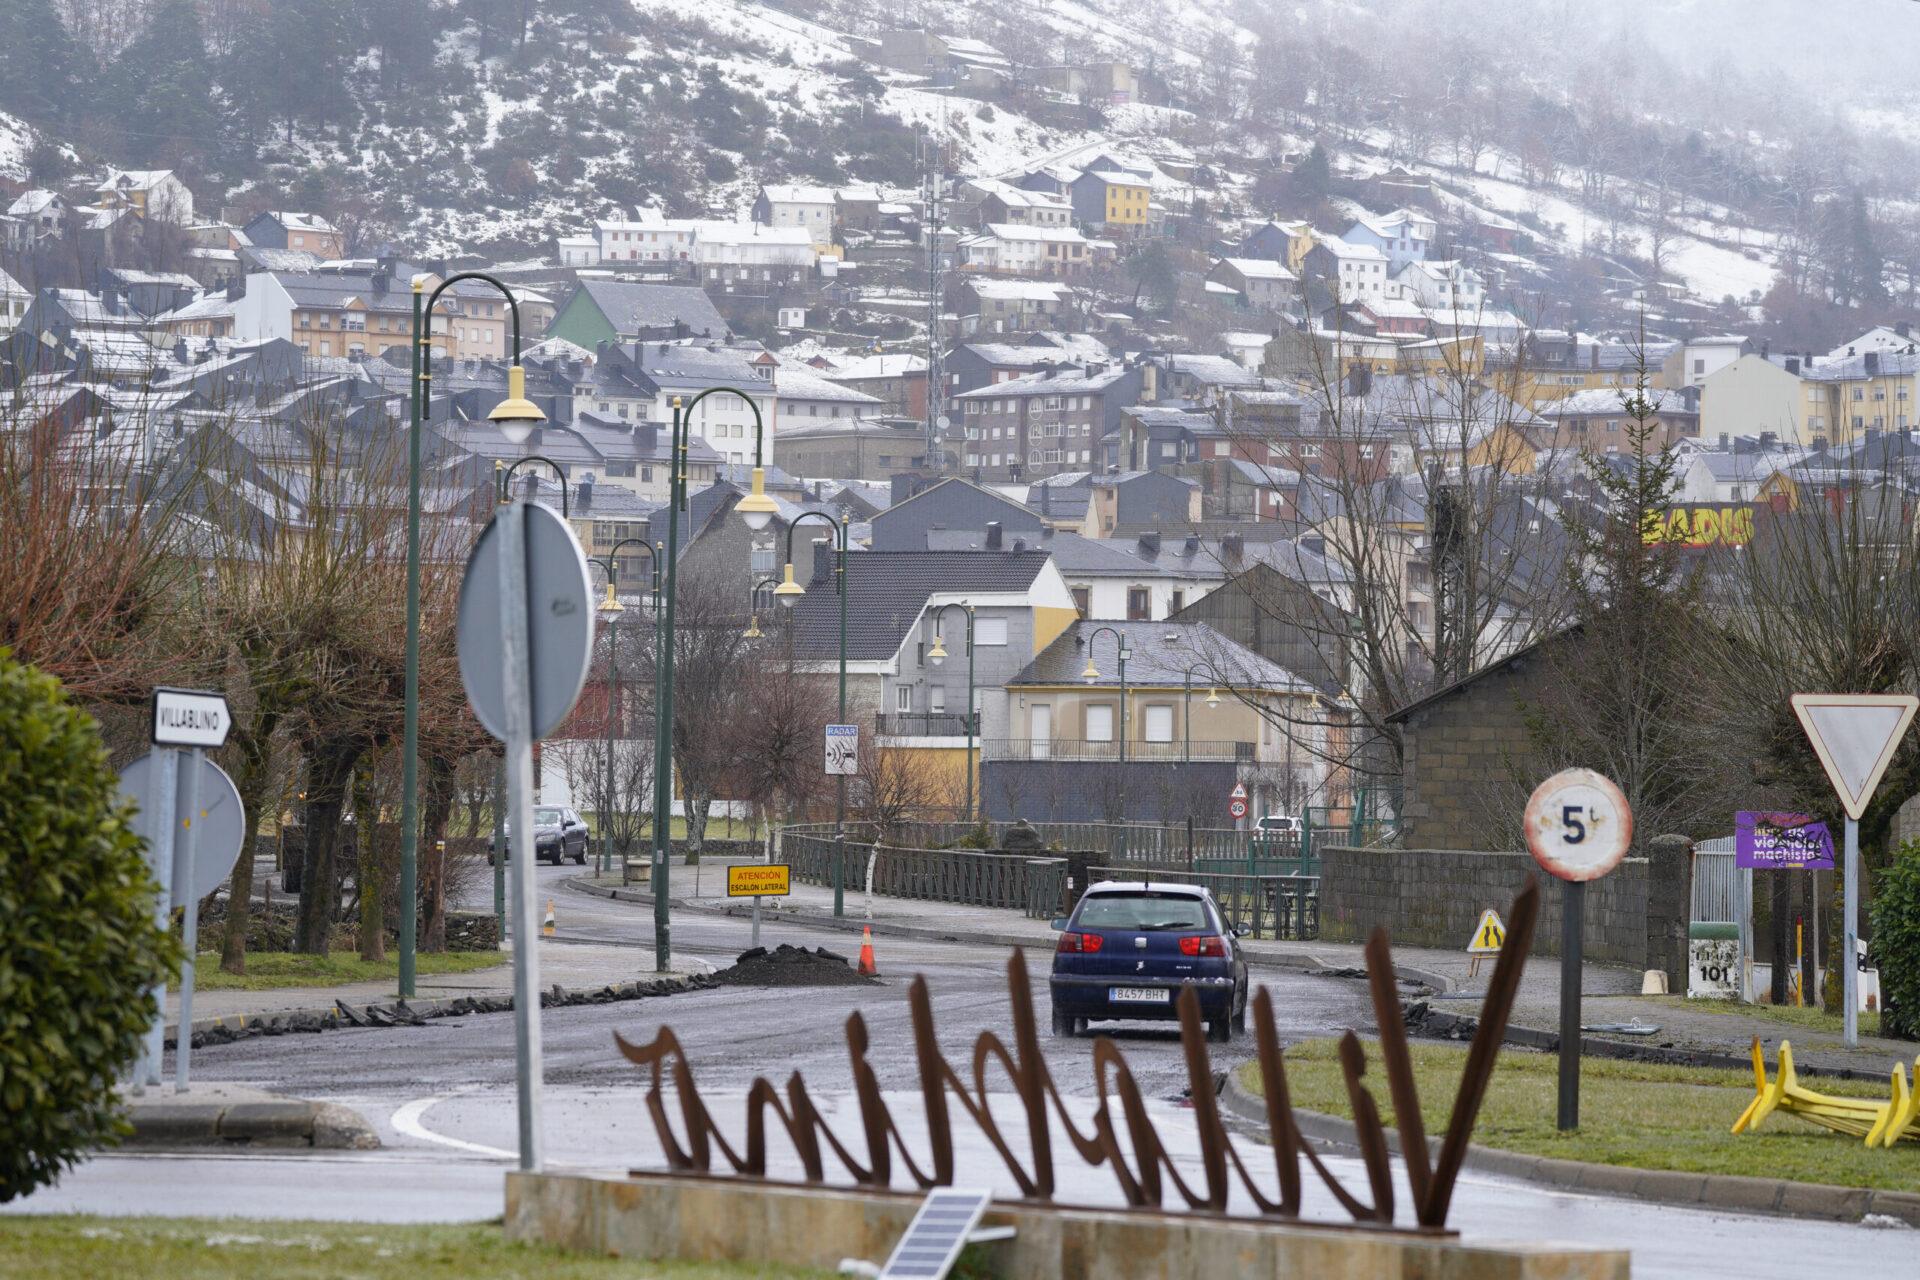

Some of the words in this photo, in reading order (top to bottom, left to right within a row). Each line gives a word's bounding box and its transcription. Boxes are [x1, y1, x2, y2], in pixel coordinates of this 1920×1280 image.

[160, 707, 219, 730] VILLABLINO
[828, 727, 855, 735] RADAR
[1562, 806, 1586, 845] 5
[738, 870, 781, 880] ATENCIÓN
[1700, 966, 1728, 982] 101
[1117, 990, 1144, 999] 8457
